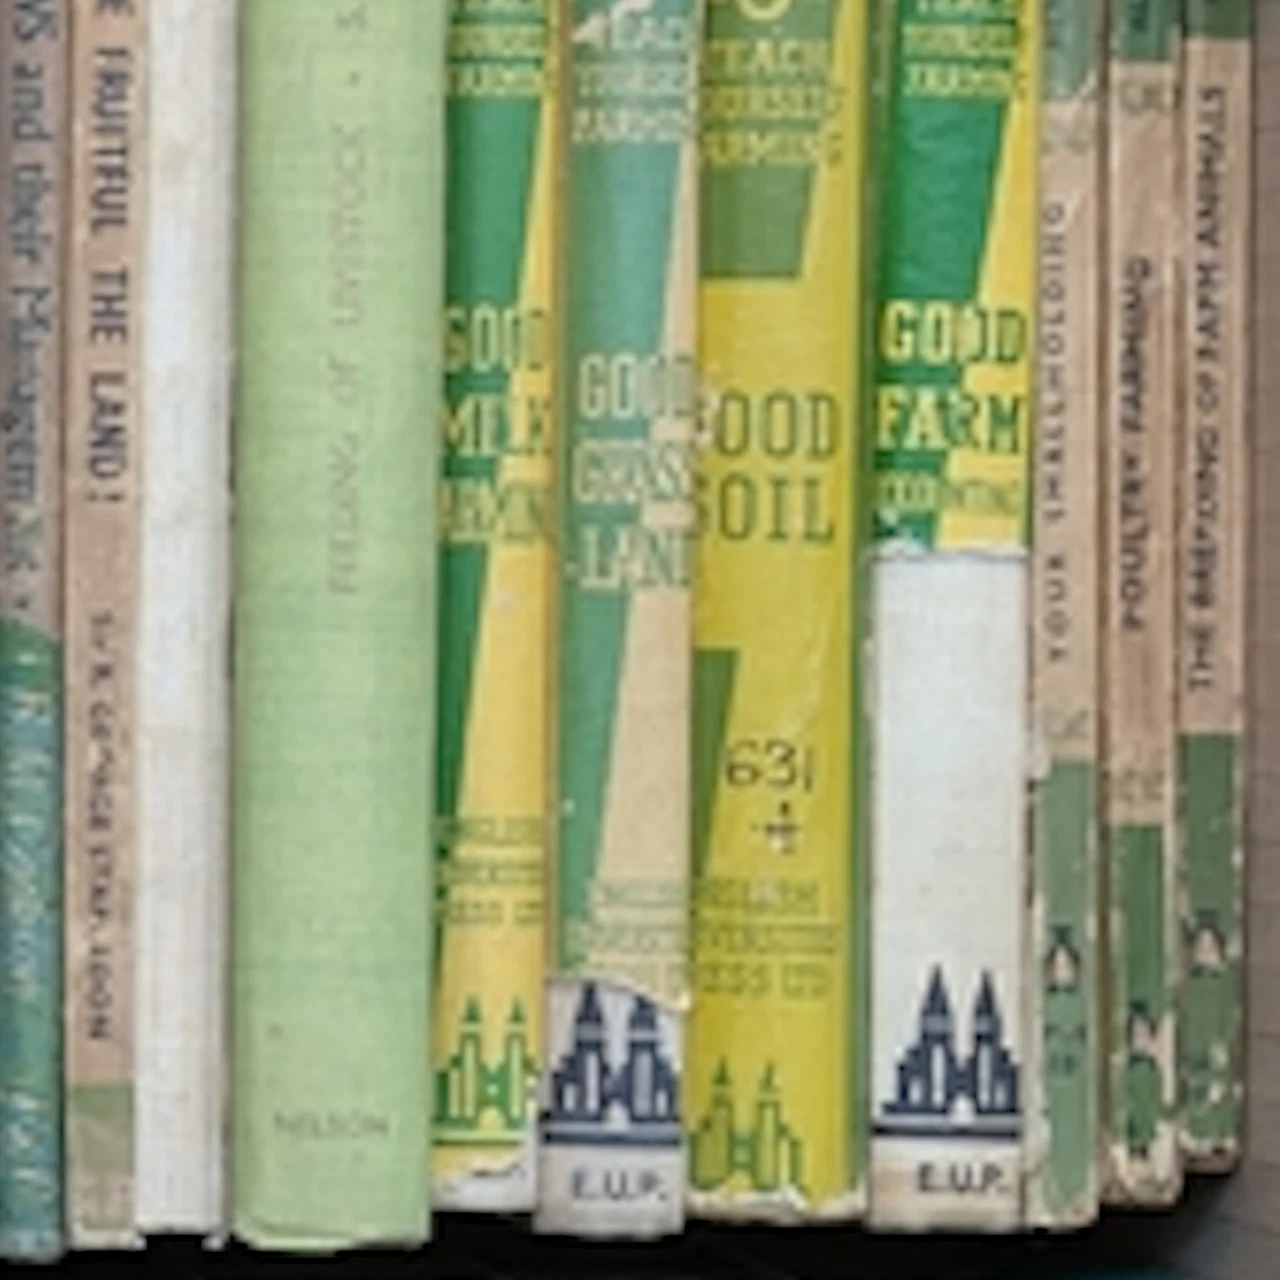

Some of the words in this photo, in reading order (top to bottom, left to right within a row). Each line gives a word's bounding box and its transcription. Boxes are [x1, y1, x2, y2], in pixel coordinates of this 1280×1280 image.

[91, 47, 134, 238] FRUITFUL
[90, 267, 132, 343] THE
[882, 298, 1027, 367] GOOD
